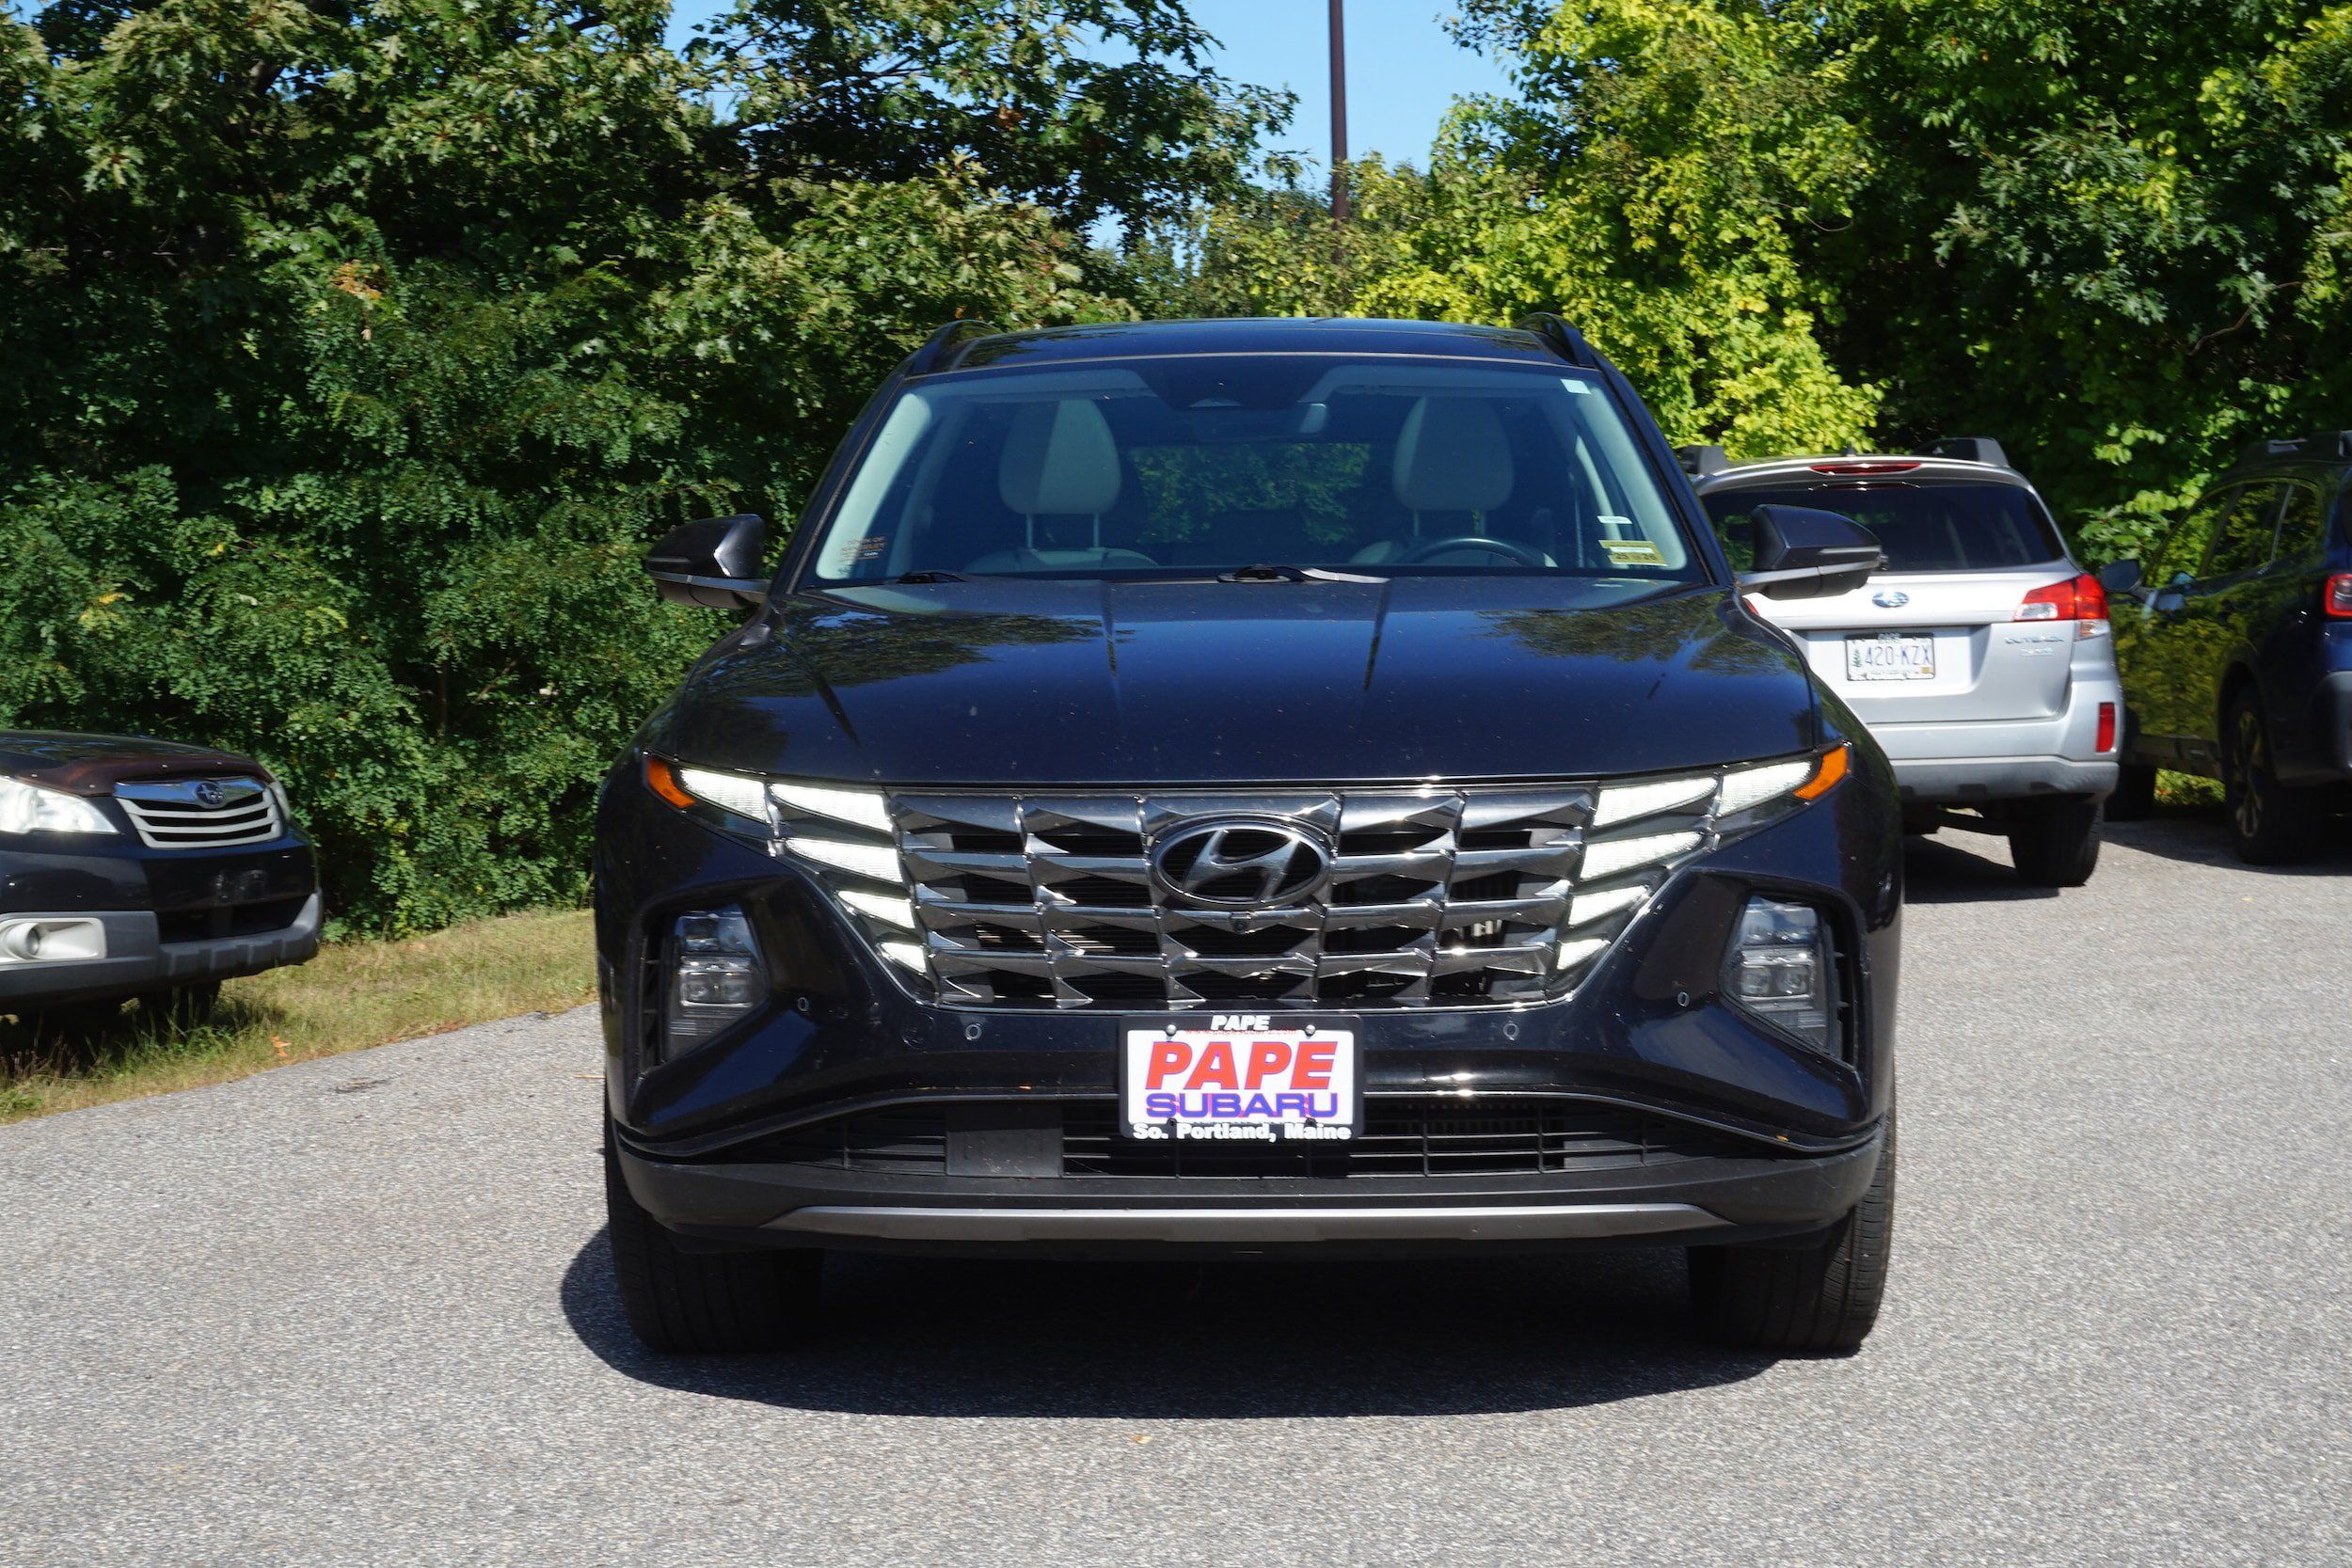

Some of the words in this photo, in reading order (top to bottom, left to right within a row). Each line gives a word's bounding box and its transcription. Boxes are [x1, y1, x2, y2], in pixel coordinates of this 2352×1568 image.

[1210, 1015, 1271, 1031] PAPE
[1145, 1041, 1338, 1090] PAPE
[1145, 1093, 1338, 1118] SUBARU
[1133, 1122, 1168, 1140] So.
[1176, 1122, 1277, 1143] Portland,
[1284, 1122, 1352, 1140] Maine
